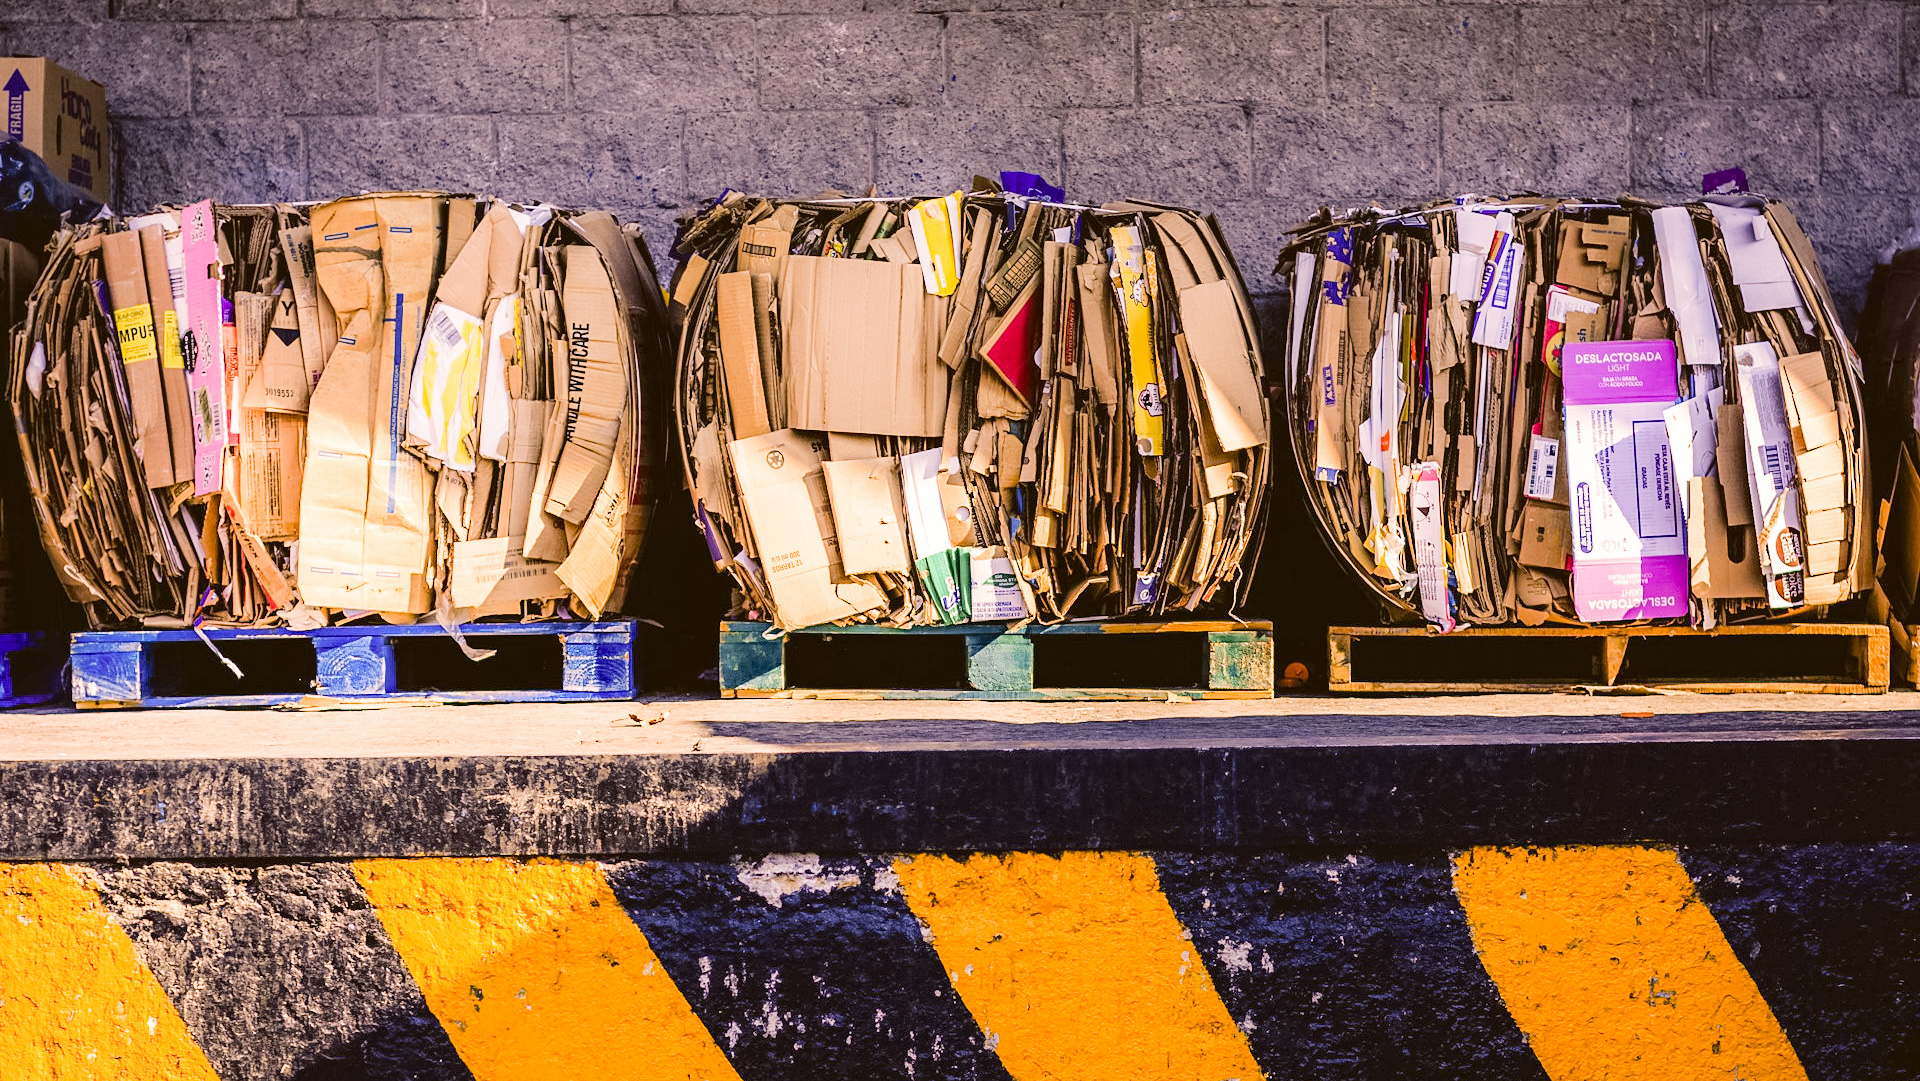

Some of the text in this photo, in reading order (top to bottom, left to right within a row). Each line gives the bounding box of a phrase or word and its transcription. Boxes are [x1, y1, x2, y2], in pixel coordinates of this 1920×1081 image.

[9, 93, 23, 135] FRAGIL
[571, 323, 589, 357] CARE
[1575, 351, 1662, 364] DESLACTOSADA
[1607, 363, 1630, 372] LIGHT
[392, 364, 400, 407] INSTRUCTIONS
[1780, 533, 1791, 563] Gusto
[771, 558, 802, 573] 12 TARROS
[1621, 588, 1643, 597] LIGHT
[1589, 597, 1675, 610] DESLACTOSADA
